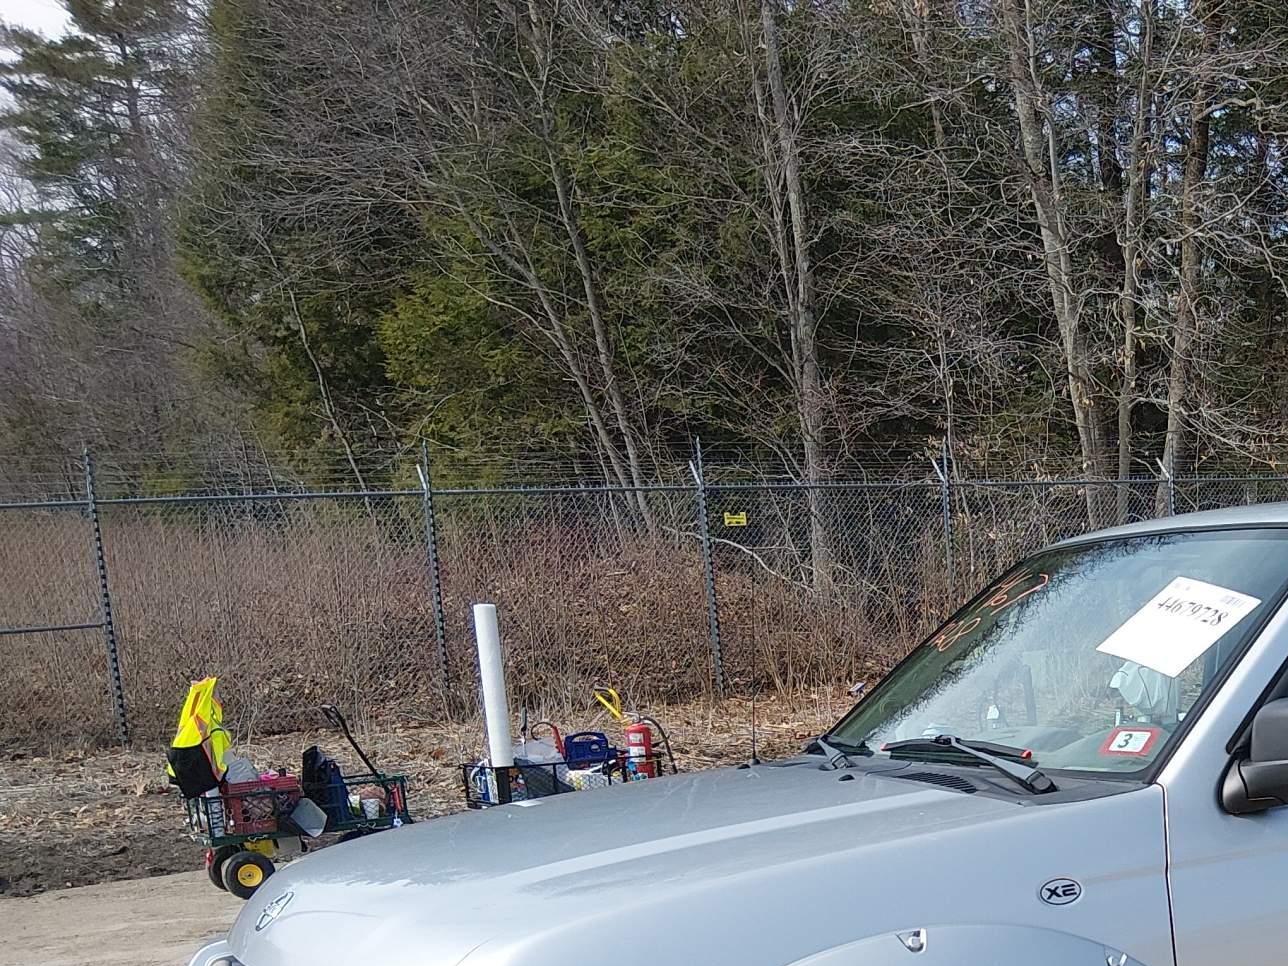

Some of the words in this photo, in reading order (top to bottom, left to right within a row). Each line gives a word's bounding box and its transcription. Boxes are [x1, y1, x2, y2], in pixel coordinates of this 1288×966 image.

[1157, 595, 1230, 627] 44679728
[1116, 732, 1134, 749] 3
[1045, 883, 1078, 900] XE
